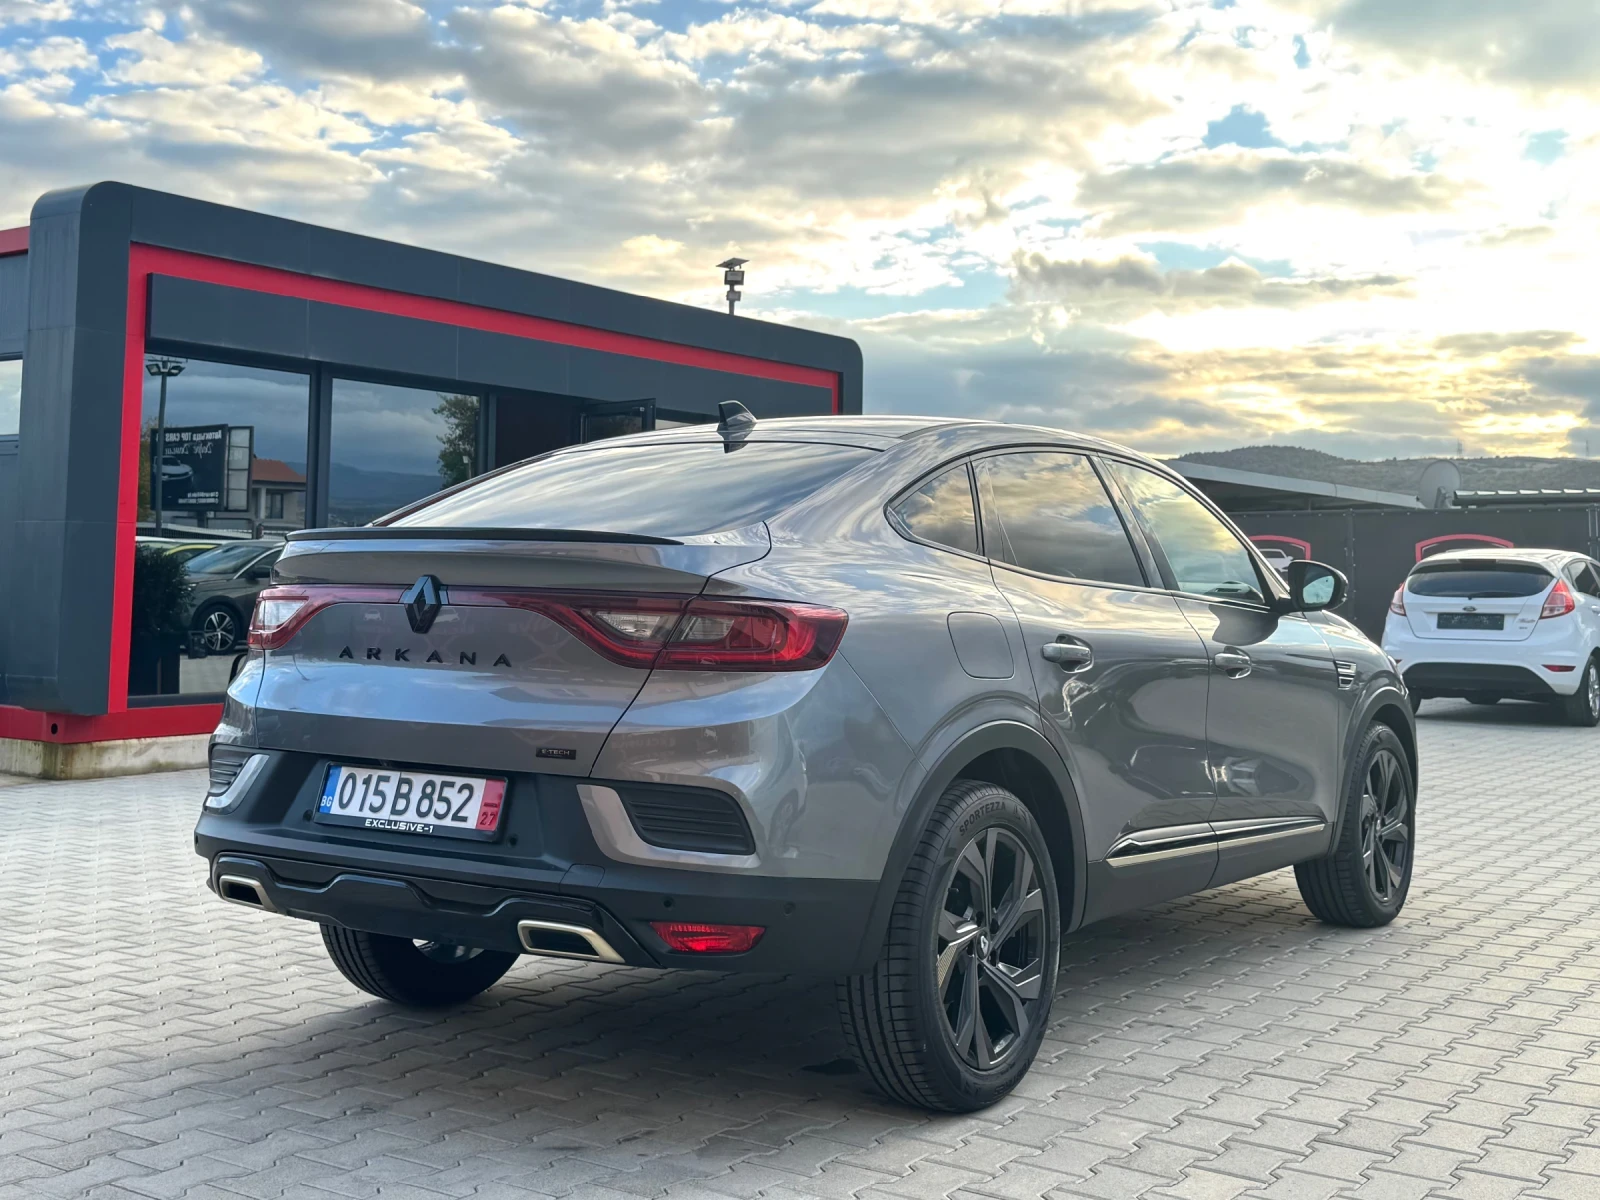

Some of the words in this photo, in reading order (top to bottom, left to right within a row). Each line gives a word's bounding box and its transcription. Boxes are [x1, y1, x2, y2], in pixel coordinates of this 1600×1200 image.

[339, 645, 512, 667] ARKANA
[321, 796, 332, 807] BG
[365, 818, 434, 833] EXCLUSIVE-1
[480, 812, 496, 826] 27
[959, 801, 1006, 836] SPORTEZZA
